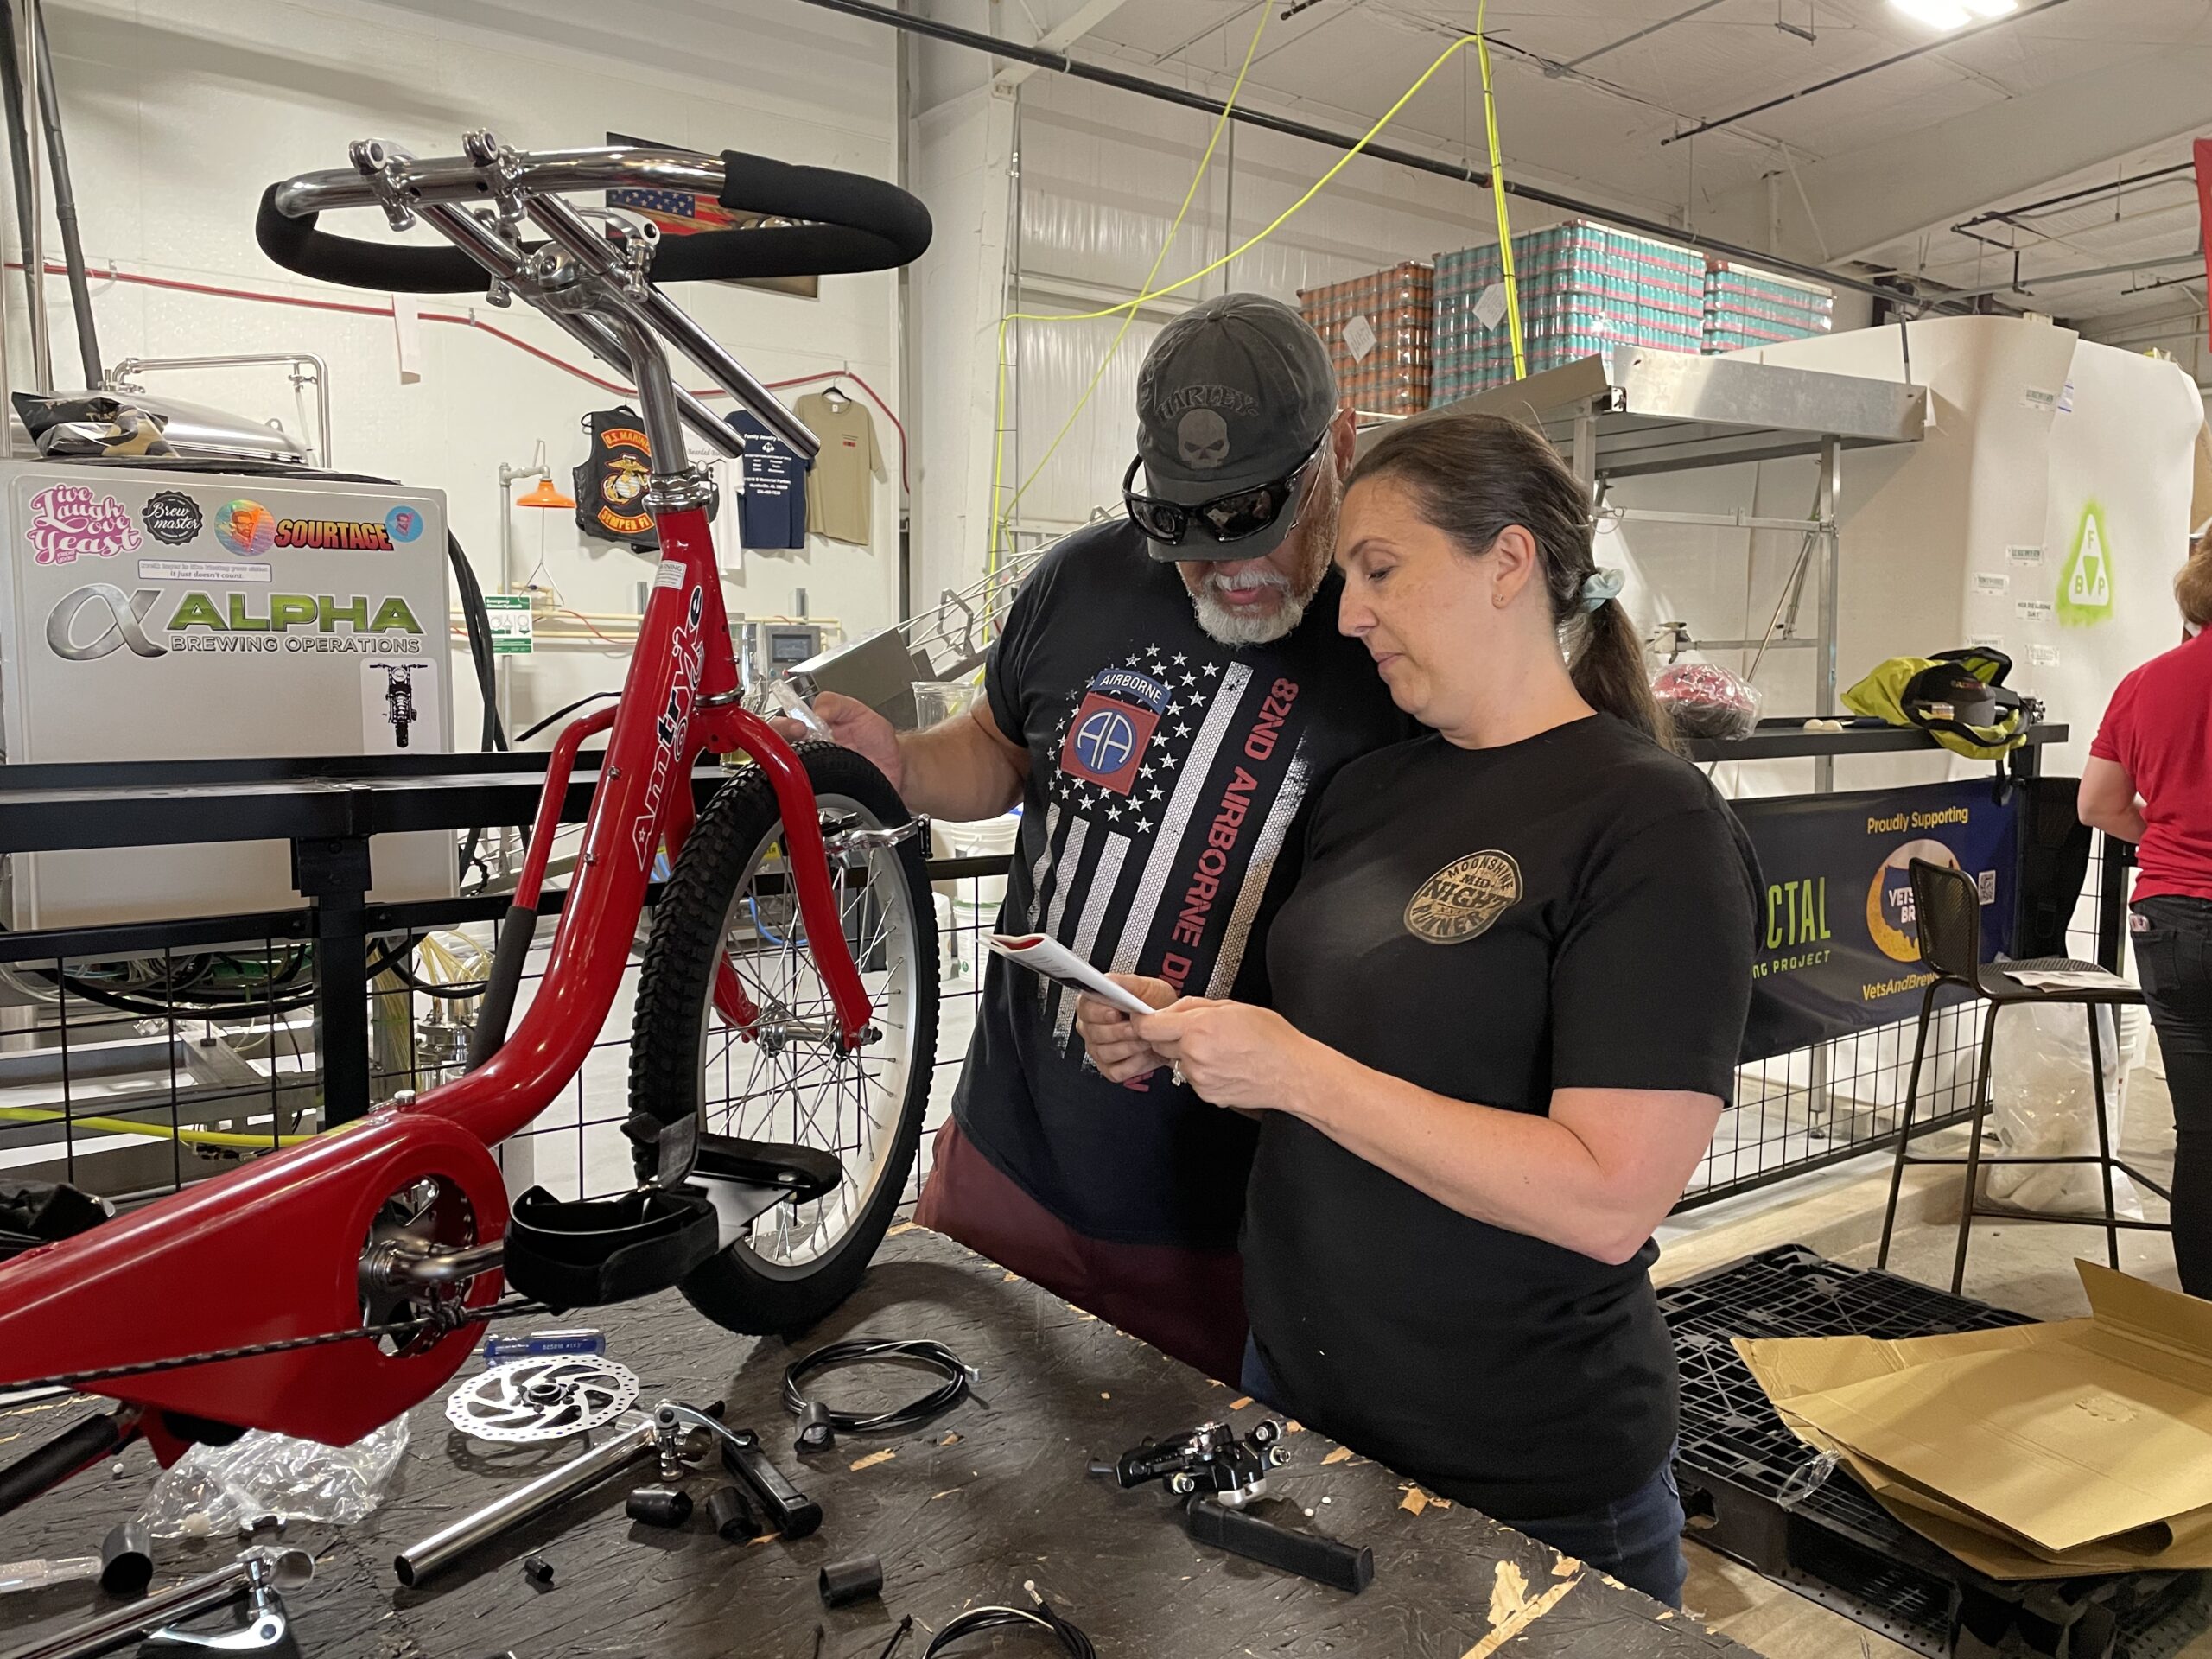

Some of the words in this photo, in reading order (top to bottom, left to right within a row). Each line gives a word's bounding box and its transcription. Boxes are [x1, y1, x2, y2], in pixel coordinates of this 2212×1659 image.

[143, 501, 190, 518] Brew
[154, 515, 200, 529] master
[601, 510, 637, 531] SEMPER
[638, 516, 650, 529] FI
[27, 529, 142, 563] Yeast
[275, 520, 394, 551] SOURTAGE
[2088, 531, 2095, 549] F
[194, 570, 220, 579] doesn't
[2075, 575, 2083, 594] B
[2097, 578, 2105, 595] P
[168, 591, 423, 634] ALPHA
[171, 636, 278, 653] BREWING
[283, 637, 420, 654] OPERATIONS
[1100, 673, 1163, 704] AIRBORNE
[1244, 677, 1300, 760] 82ND
[1867, 813, 1909, 834] Proudly
[1911, 805, 1969, 829] Supporting
[1171, 766, 1258, 949] AIRBORNE
[1447, 856, 1513, 891] MOONSHINE
[1421, 879, 1514, 908] NIGHT
[1767, 876, 1831, 950] CTAL
[1773, 950, 1831, 974] PROJECT
[1863, 972, 1940, 1001] VetsAndBrew
